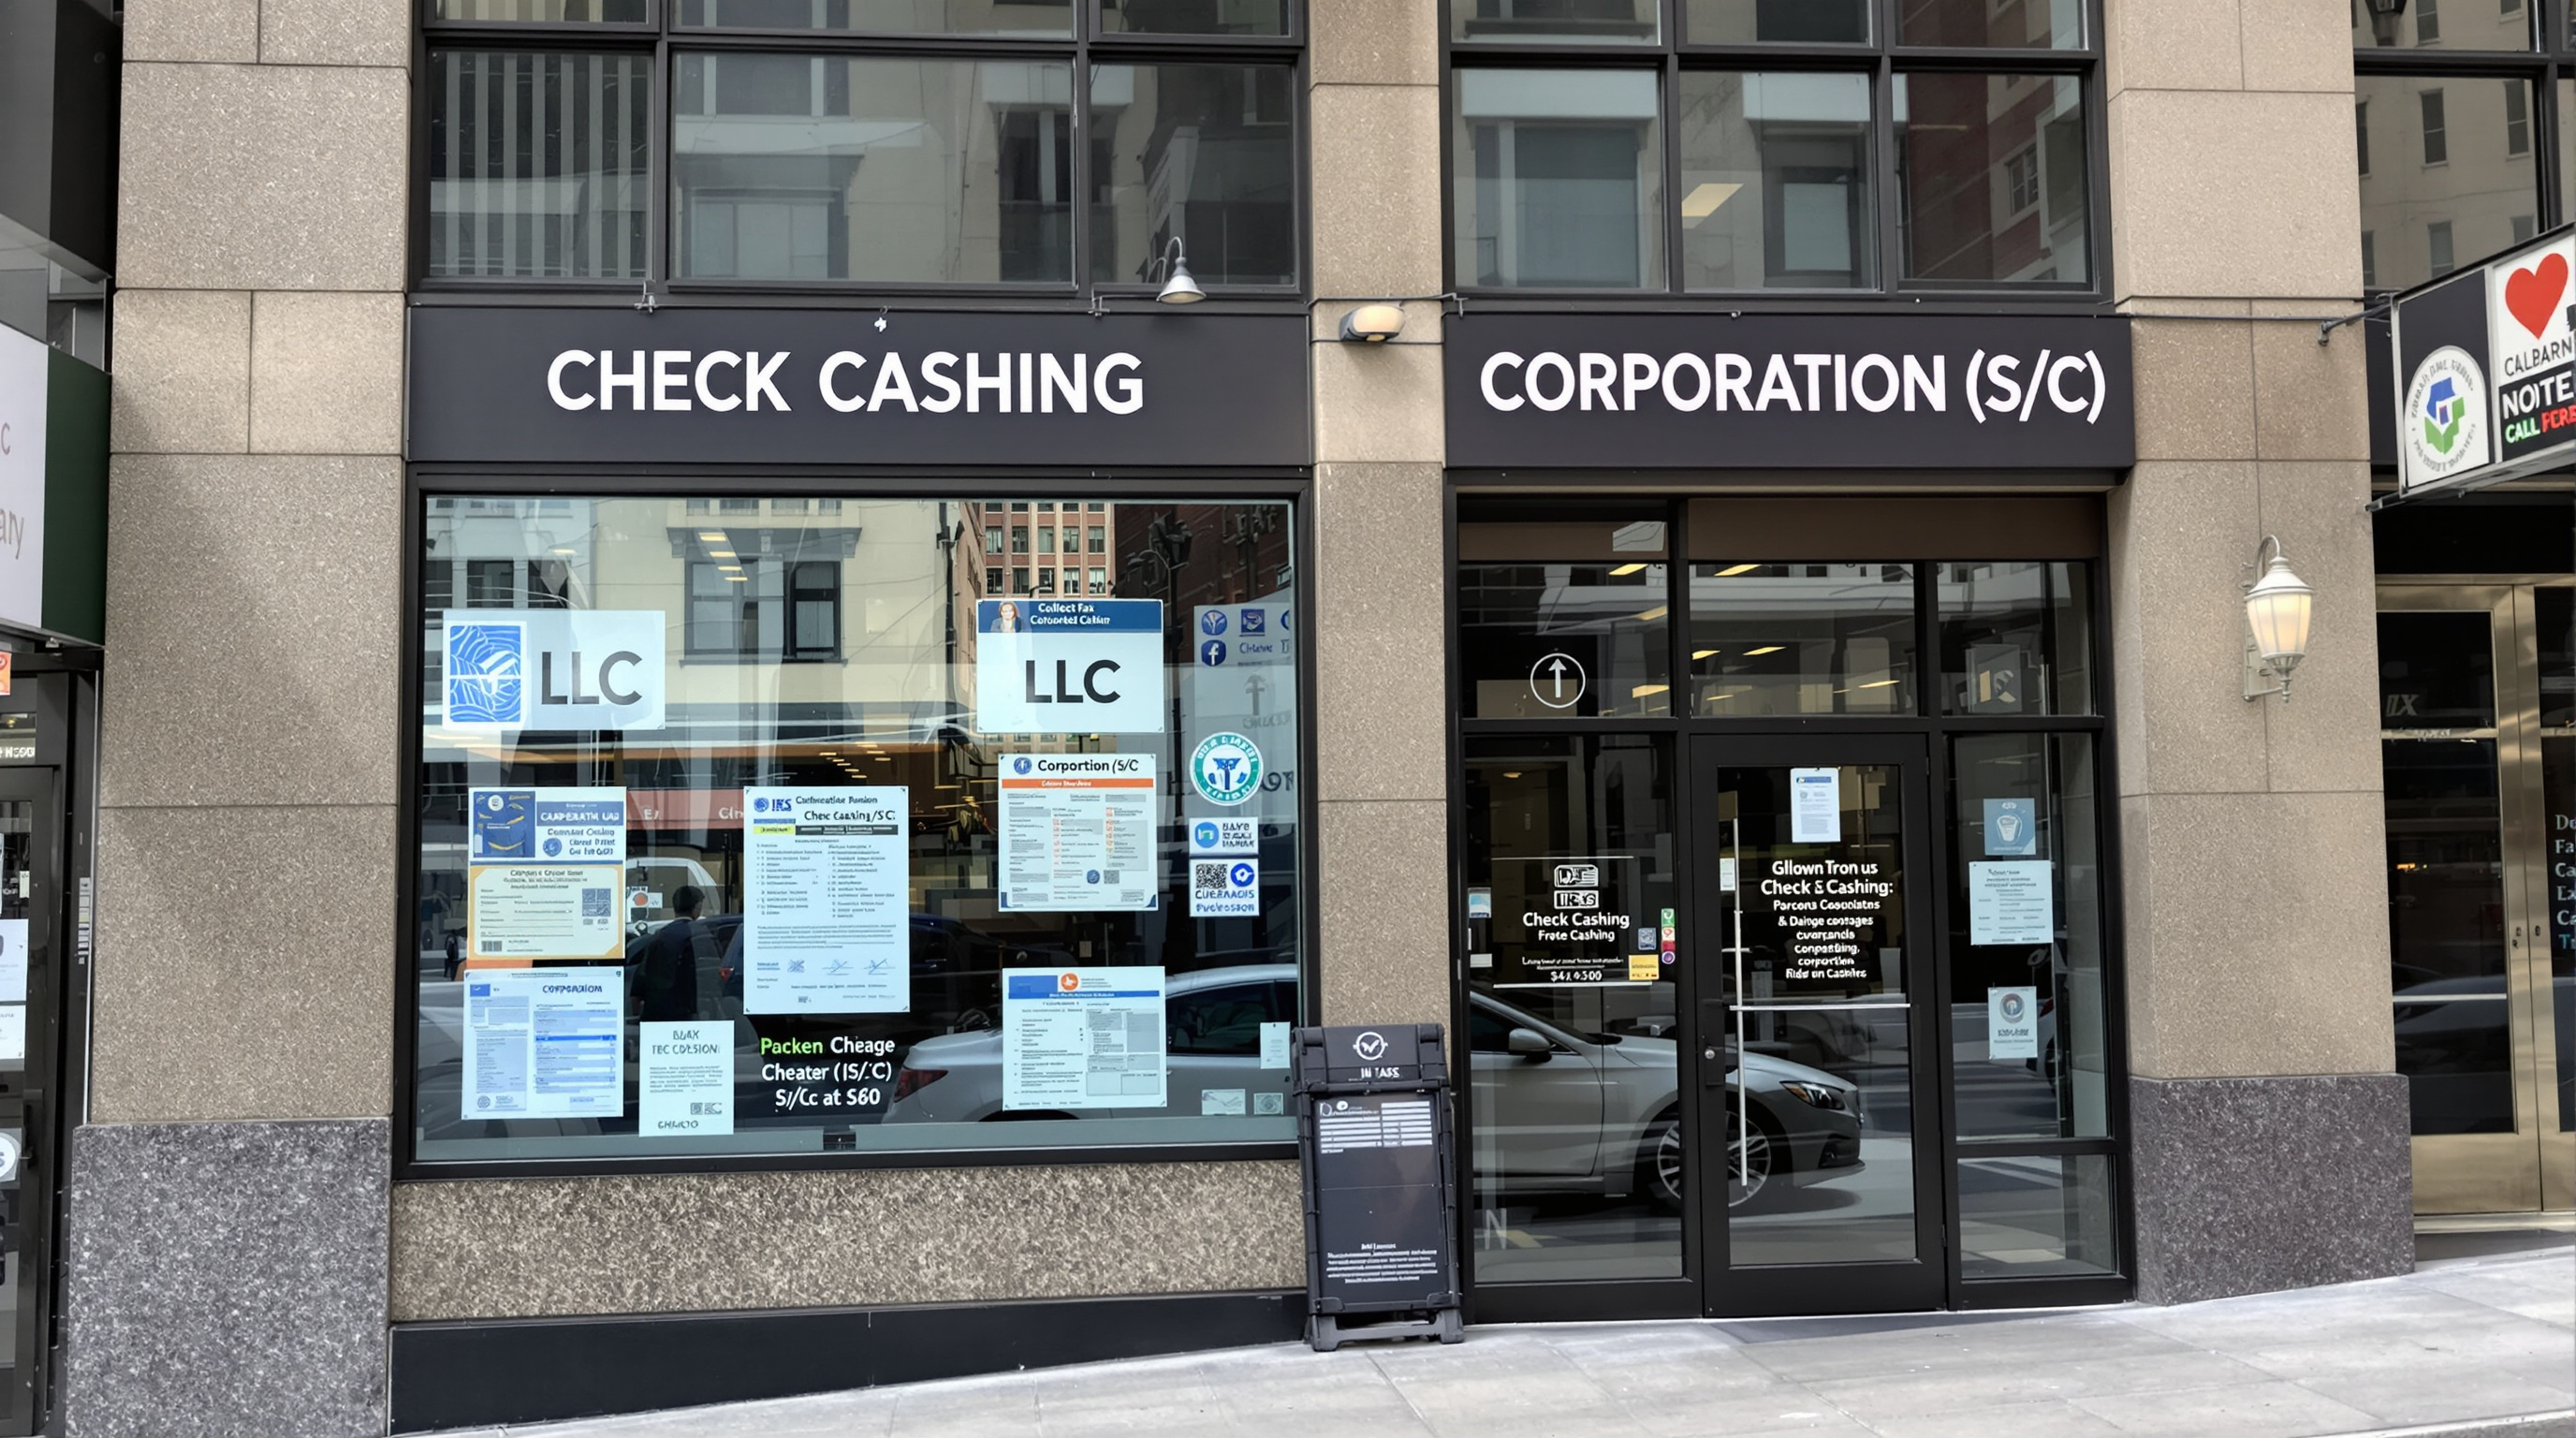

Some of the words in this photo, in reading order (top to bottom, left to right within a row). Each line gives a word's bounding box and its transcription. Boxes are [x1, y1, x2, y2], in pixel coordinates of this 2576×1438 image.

[547, 349, 792, 413] CHECK
[818, 350, 1144, 415] CASHING
[1480, 351, 1946, 413] CORPORATION
[1966, 349, 2106, 424] (S/C)
[2505, 417, 2541, 444] CALL
[541, 651, 643, 706] LLC
[1026, 659, 1121, 704] LLC
[1824, 859, 1859, 875] Tron
[1860, 863, 1879, 875] us
[1761, 878, 1811, 895] Check
[1826, 878, 1894, 897] Cashing:
[1522, 912, 1570, 927] Check
[1572, 911, 1631, 929] Cashing
[760, 1036, 824, 1056] Packen
[829, 1035, 896, 1057] Cheage
[761, 1063, 830, 1081] Cheater
[822, 1088, 842, 1106] at
